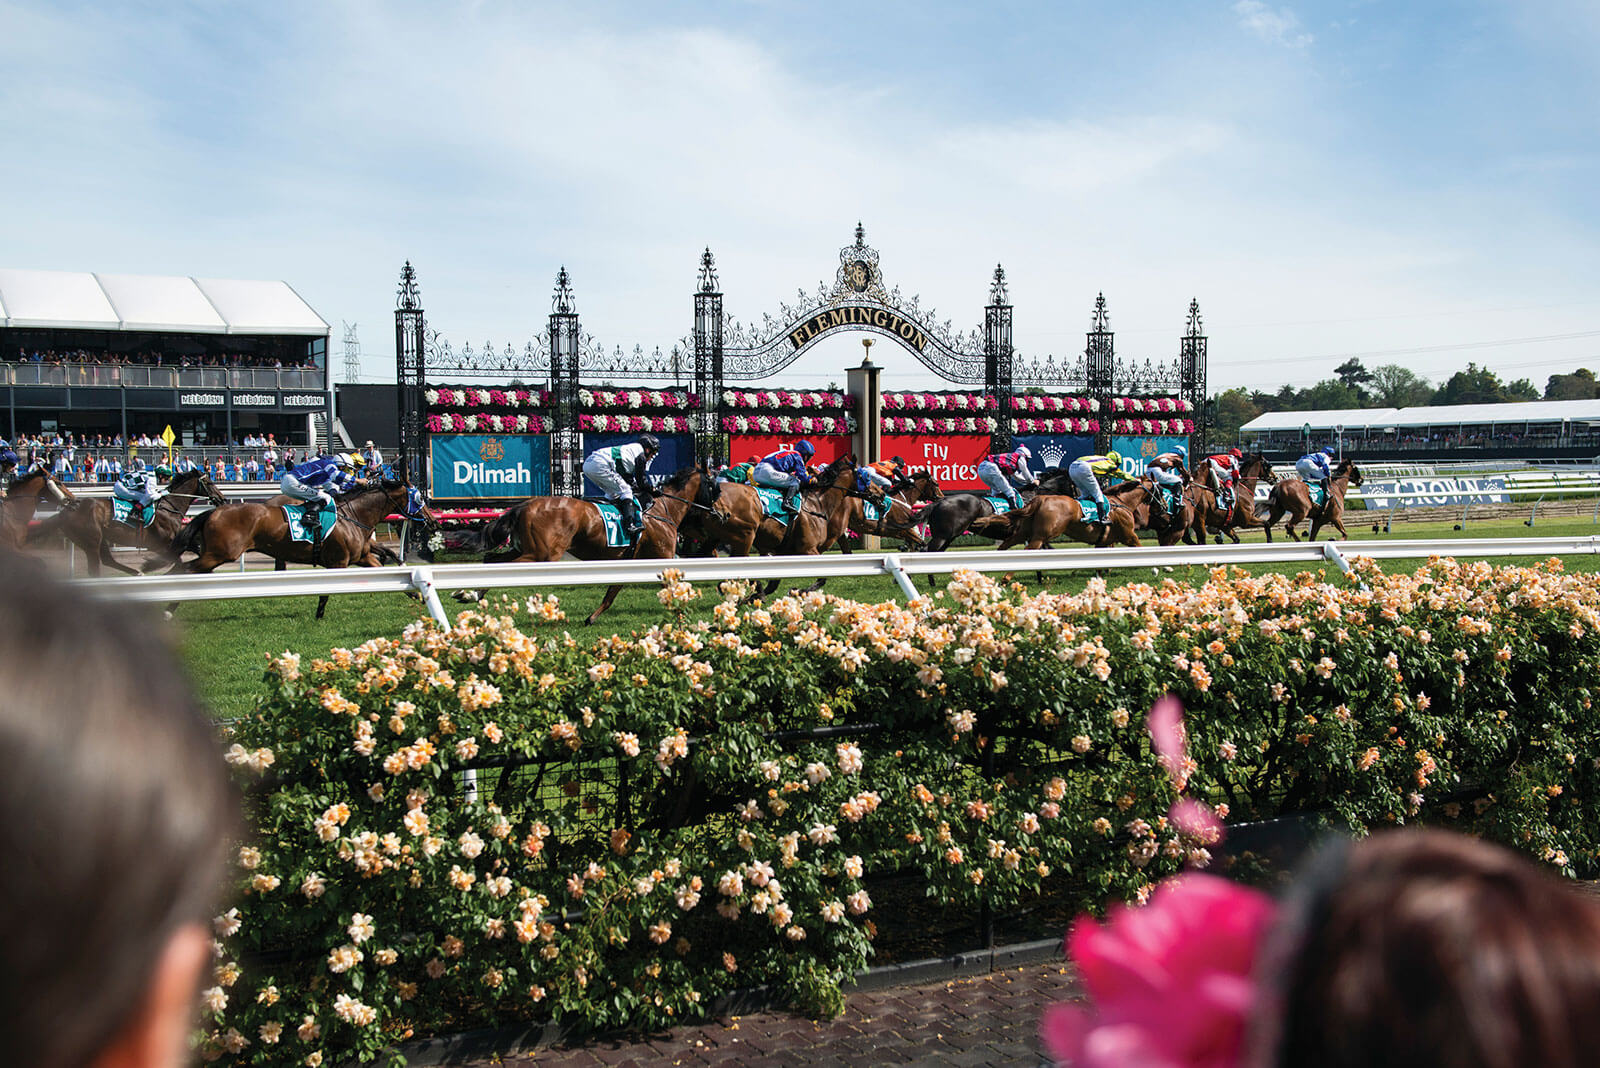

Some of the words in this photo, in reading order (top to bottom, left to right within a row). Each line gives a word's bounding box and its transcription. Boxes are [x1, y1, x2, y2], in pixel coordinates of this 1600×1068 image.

[791, 307, 928, 351] FLEMINGTON
[923, 443, 949, 461] Fly
[453, 461, 531, 484] Dilmah
[904, 460, 978, 481] mirates
[1394, 479, 1484, 506] CROWN
[607, 521, 618, 545] 7
